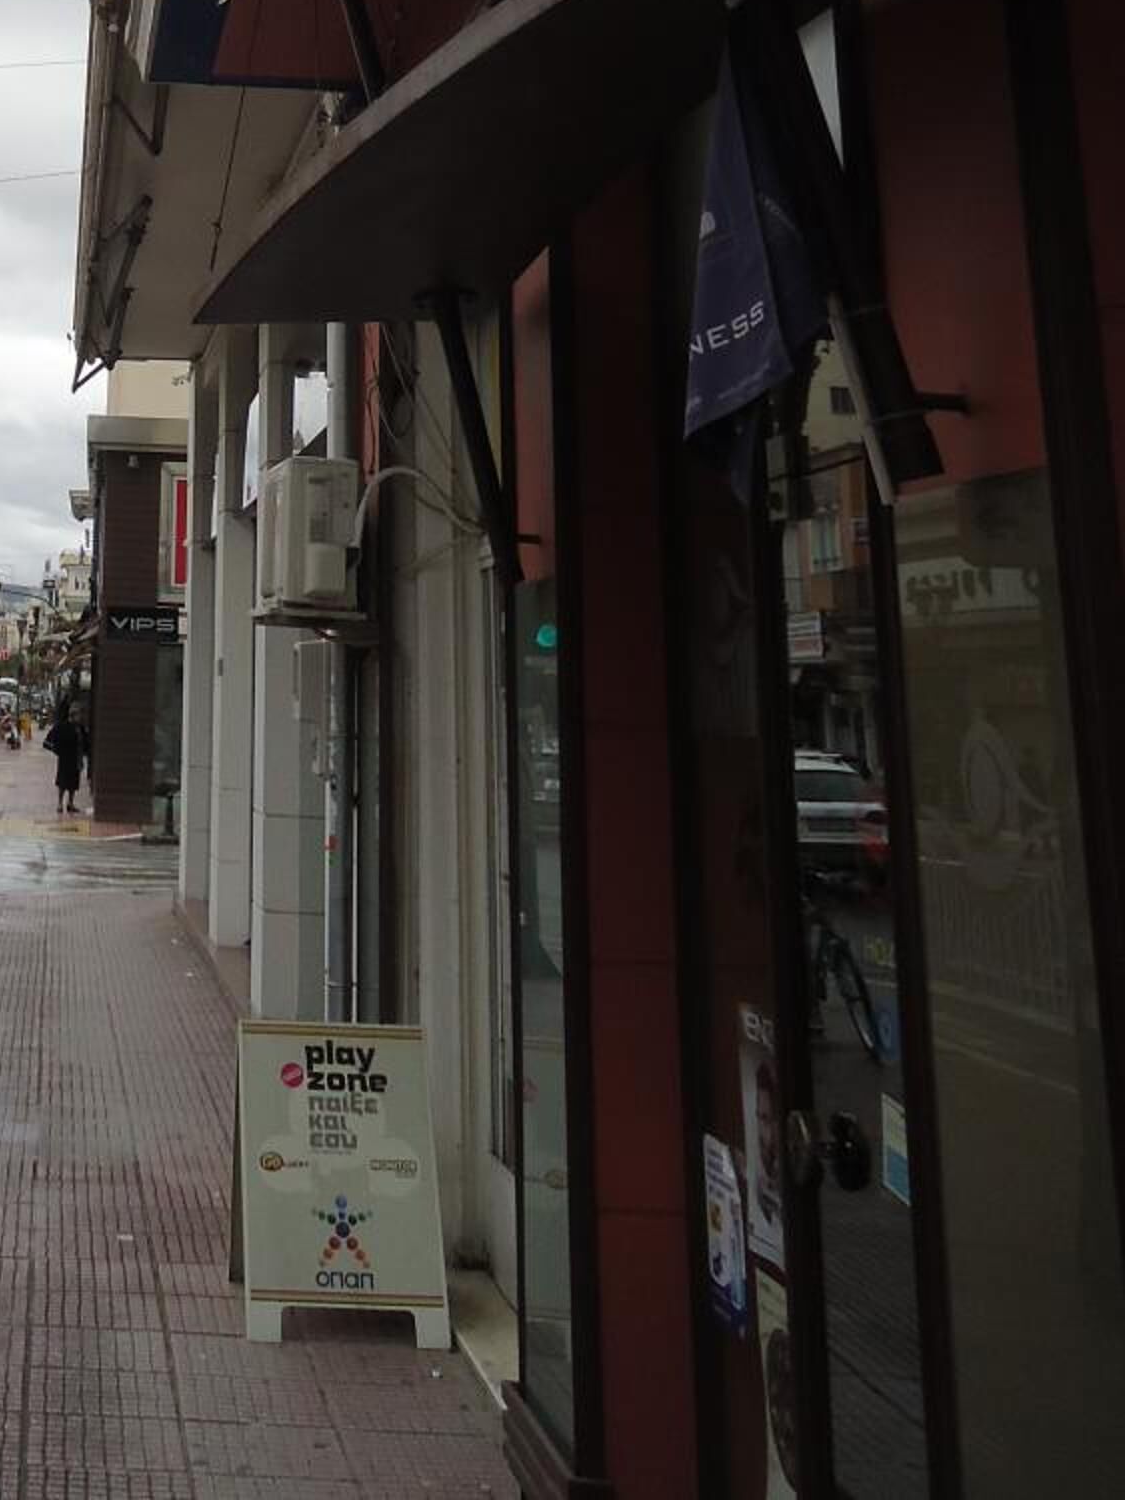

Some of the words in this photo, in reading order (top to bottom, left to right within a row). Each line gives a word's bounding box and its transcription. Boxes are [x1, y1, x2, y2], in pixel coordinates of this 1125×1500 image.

[110, 616, 175, 632] VIPS
[304, 1040, 375, 1073] play
[306, 1071, 388, 1092] zone
